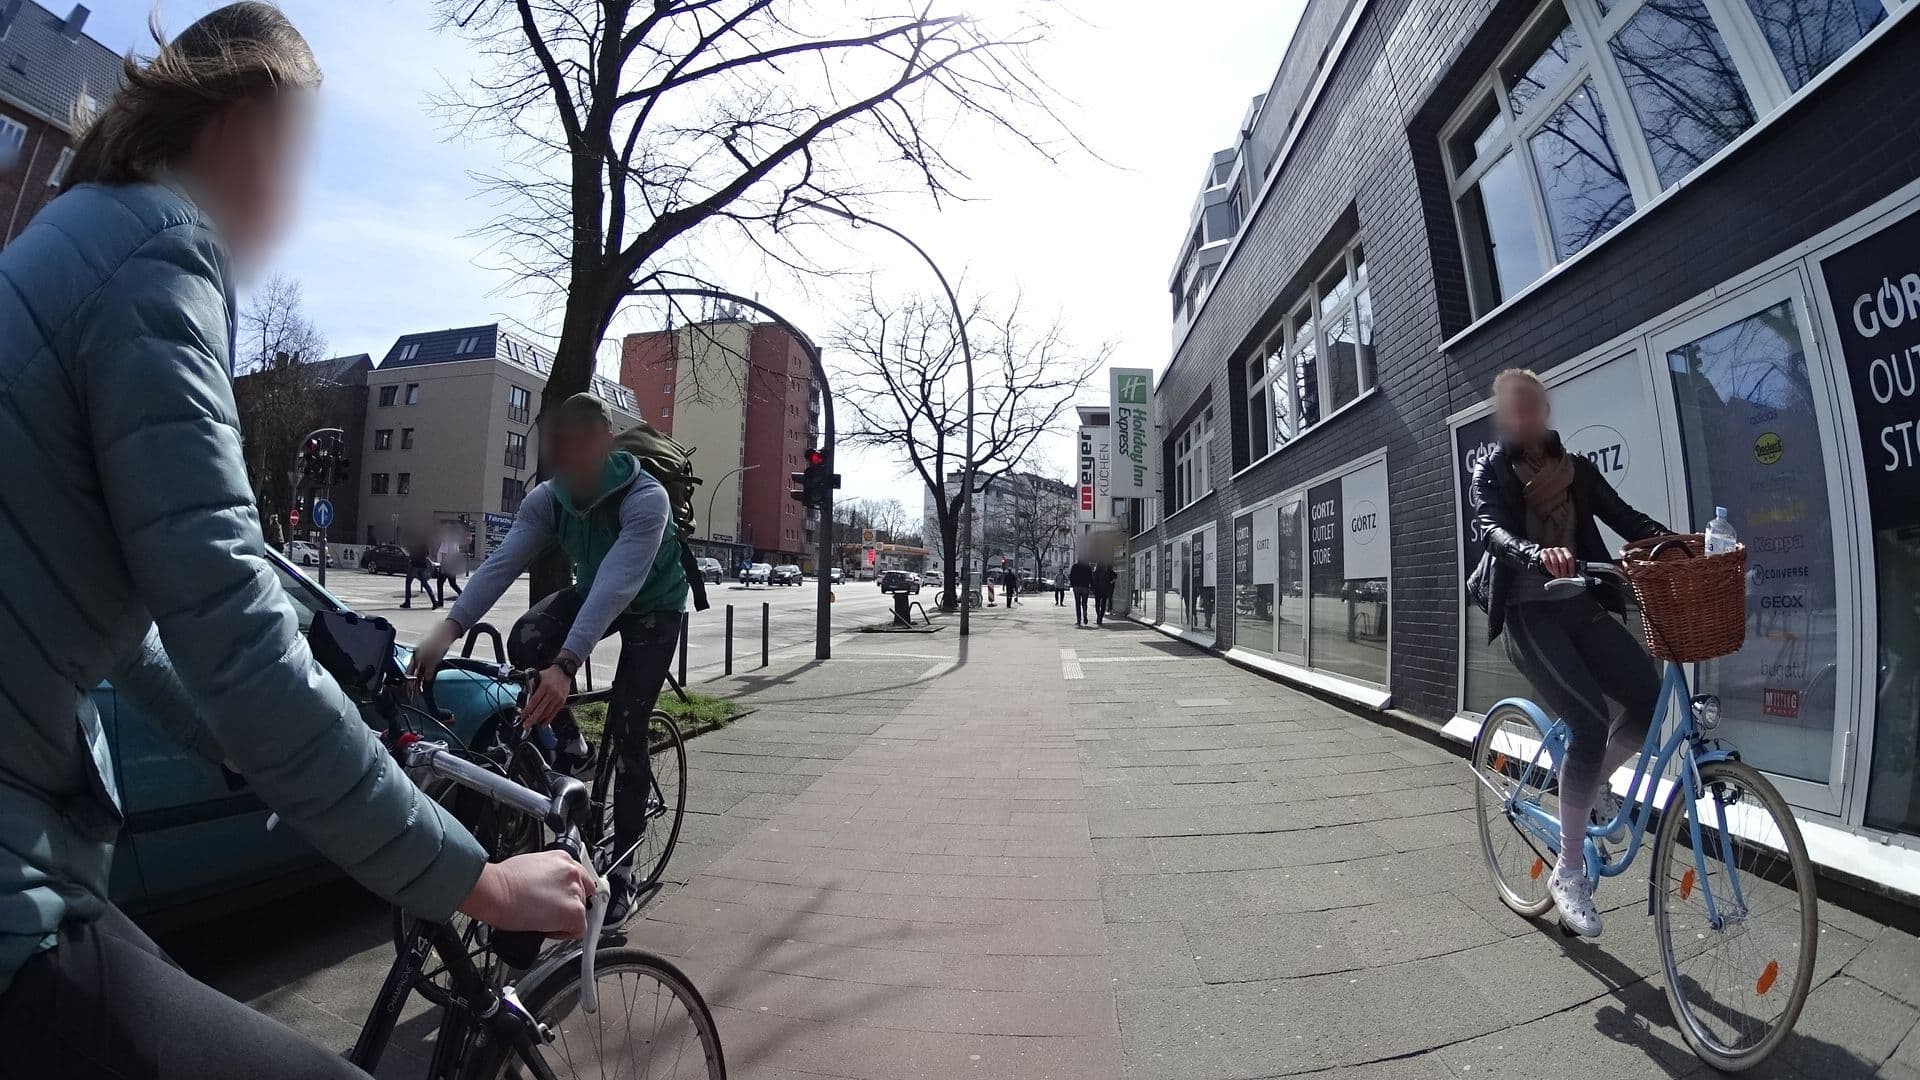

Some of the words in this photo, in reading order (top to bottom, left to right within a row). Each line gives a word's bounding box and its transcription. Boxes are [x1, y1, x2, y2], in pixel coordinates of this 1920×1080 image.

[1116, 407, 1131, 457] Express
[1130, 408, 1147, 465] Holiday
[1880, 418, 1920, 472] ST
[1081, 431, 1096, 511] meyer
[1133, 465, 1148, 487] Inn
[1312, 523, 1335, 543] OUTLET
[1312, 547, 1331, 565] STORE
[1765, 566, 1809, 580] CONVERSE
[1760, 595, 1804, 609] GEOX
[411, 935, 429, 957] 14
